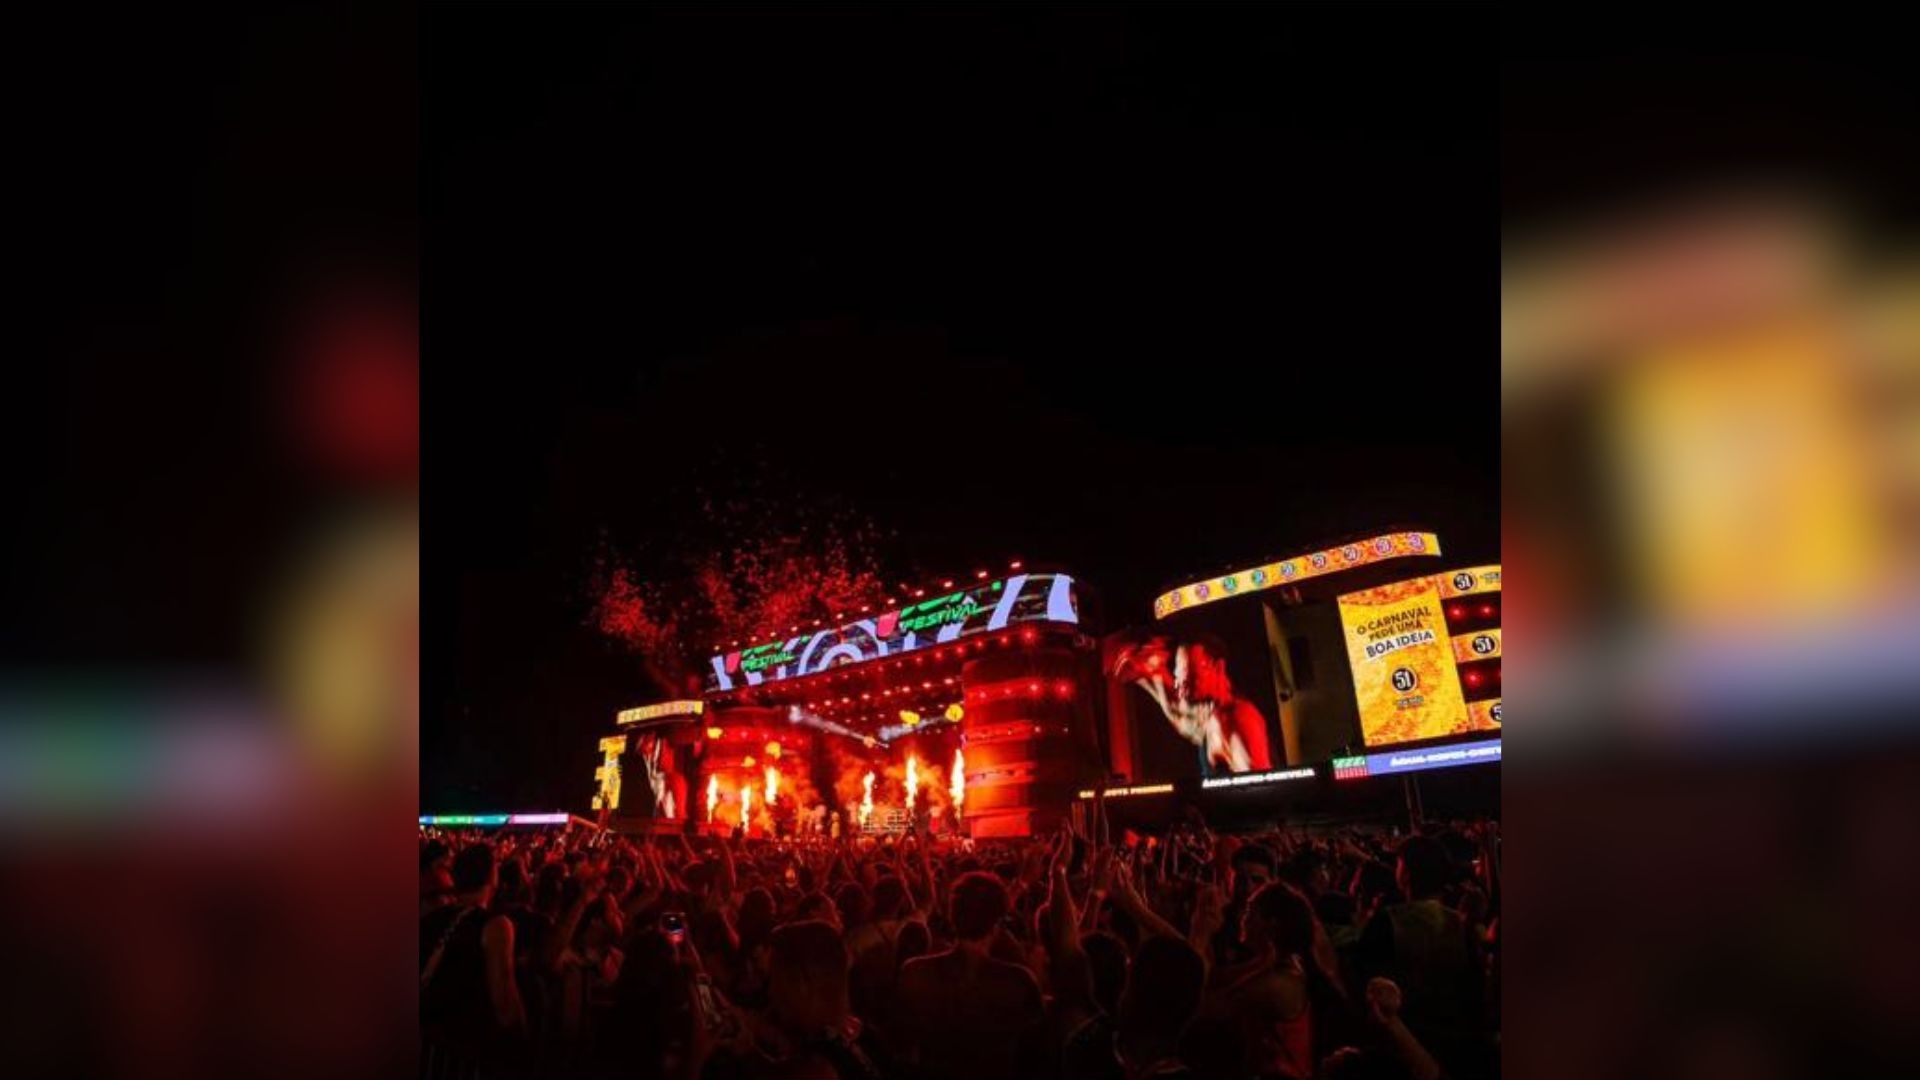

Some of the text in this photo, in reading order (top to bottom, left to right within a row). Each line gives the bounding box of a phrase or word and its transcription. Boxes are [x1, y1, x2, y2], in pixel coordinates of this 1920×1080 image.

[1456, 574, 1471, 589] 51
[899, 602, 978, 633] FESTIVAL
[1357, 606, 1432, 635] O CARNAVAL
[1368, 620, 1423, 641] PEDE UMA
[1366, 631, 1433, 657] BOA IDEIA
[1475, 637, 1492, 652] 51
[1395, 671, 1412, 689] 51
